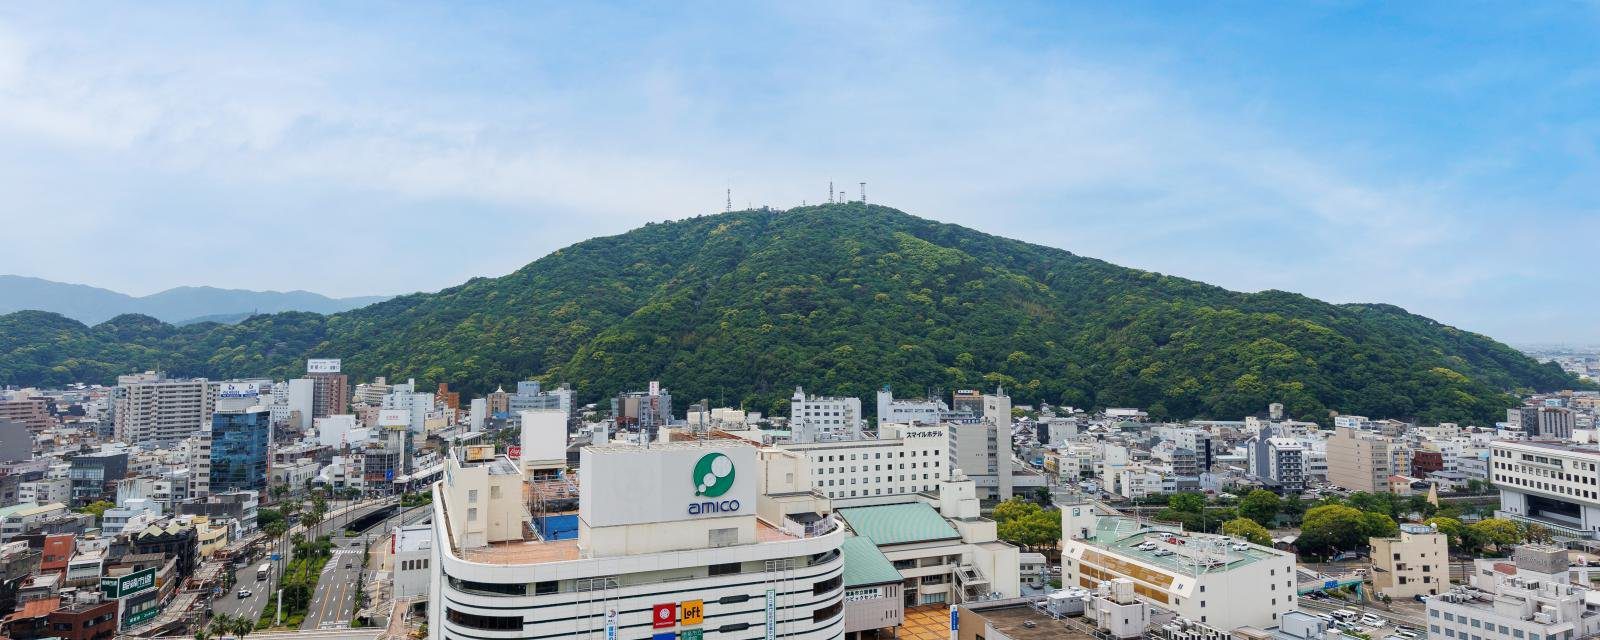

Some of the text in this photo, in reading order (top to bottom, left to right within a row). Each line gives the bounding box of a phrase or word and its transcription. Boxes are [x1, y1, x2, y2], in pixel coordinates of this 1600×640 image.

[906, 430, 943, 439] スマイルホテル
[688, 499, 740, 515] amico
